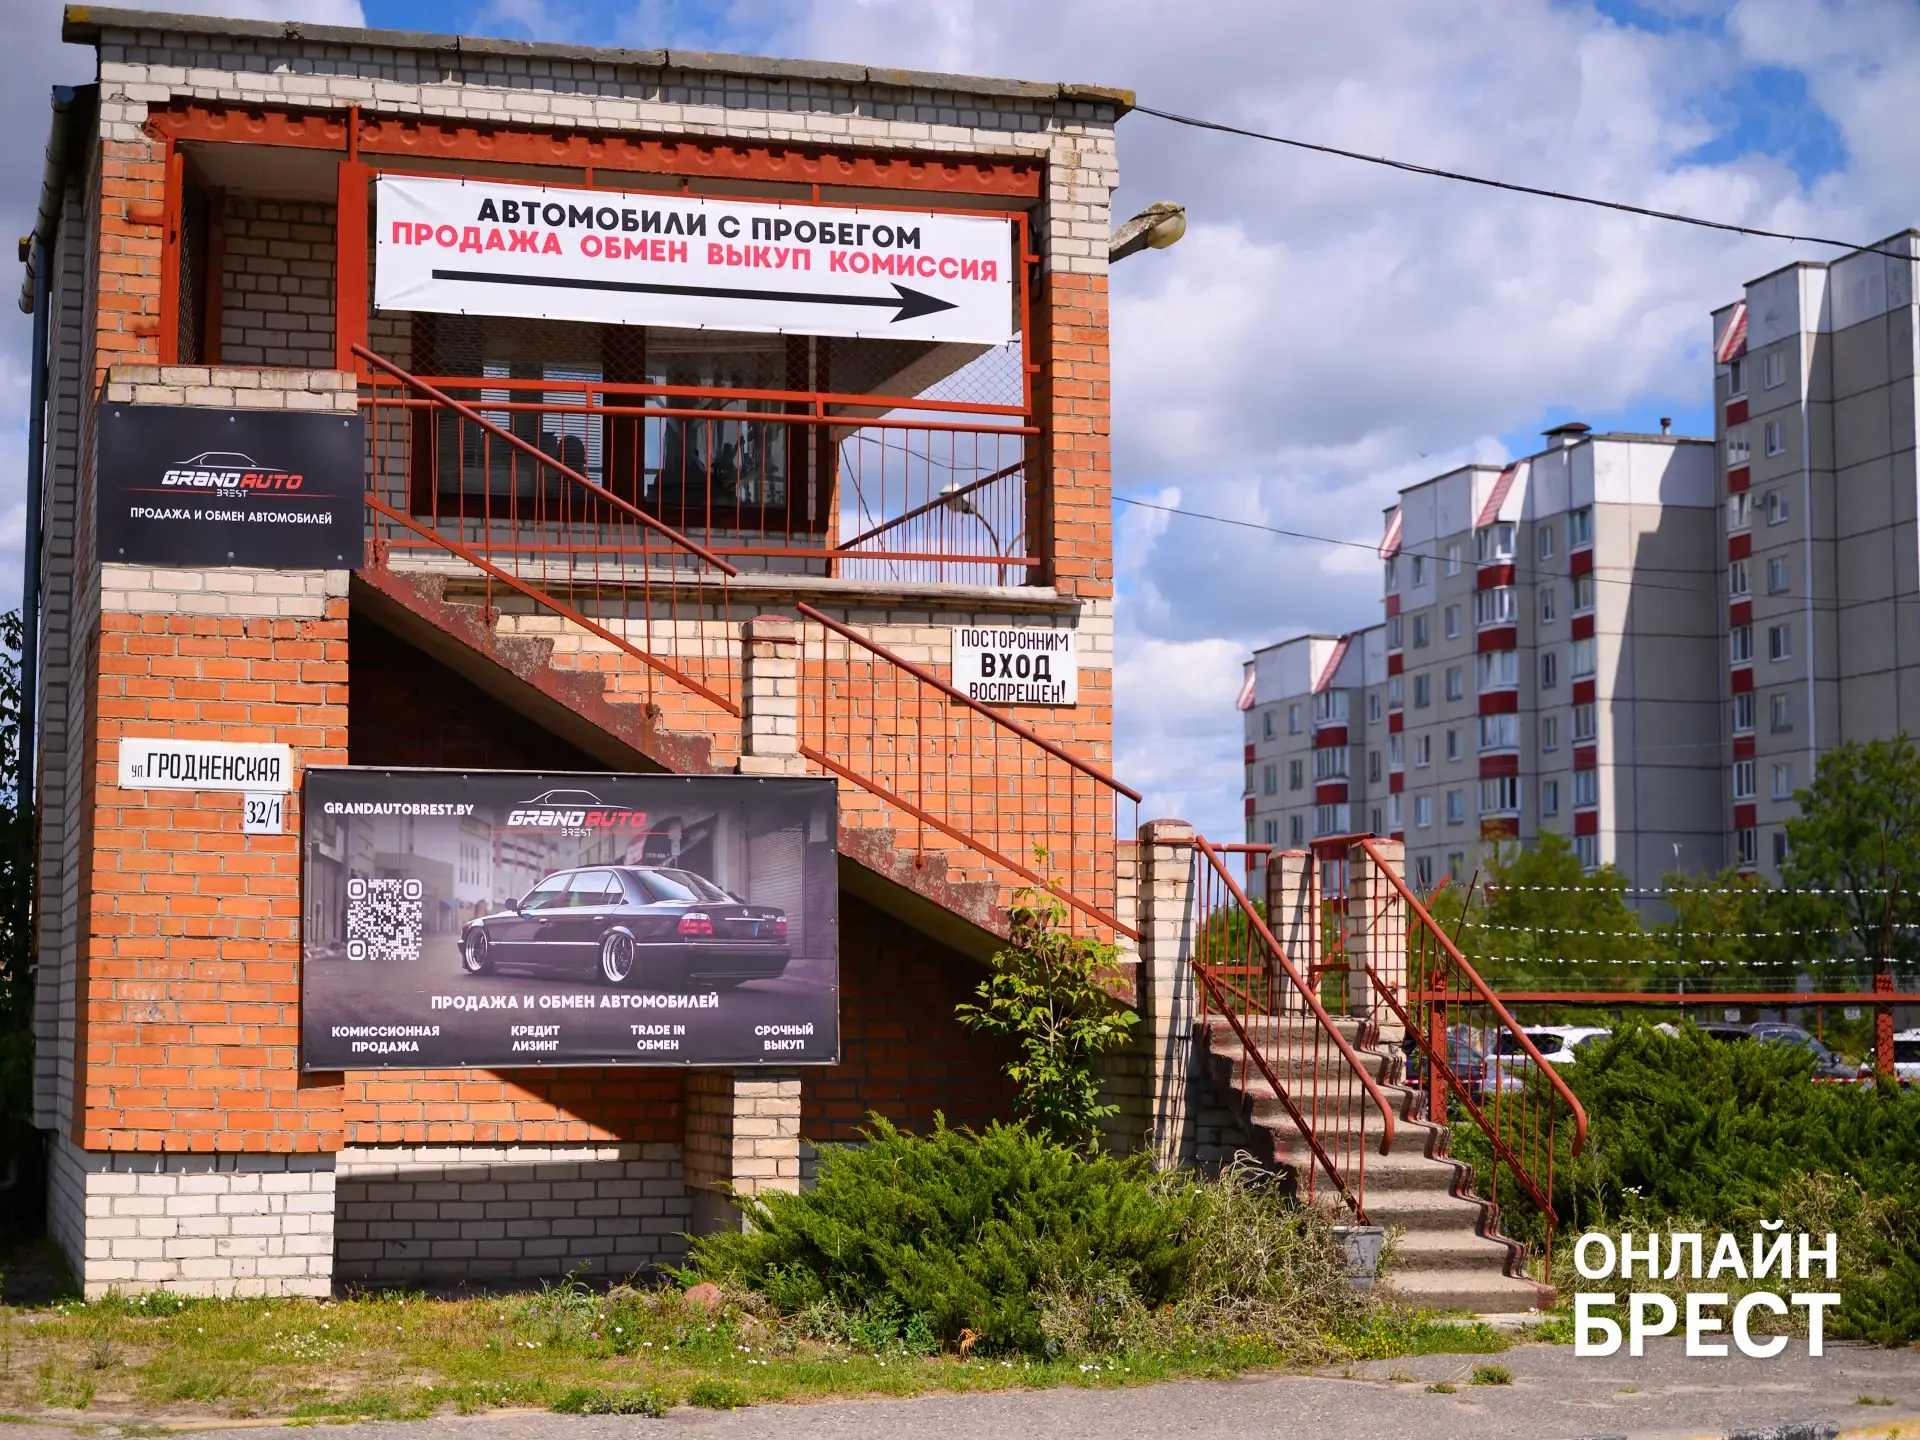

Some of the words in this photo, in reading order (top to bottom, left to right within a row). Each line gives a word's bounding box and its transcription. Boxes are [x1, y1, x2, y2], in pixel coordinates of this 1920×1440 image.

[477, 198, 707, 237] АВТОМОБИЛИ
[718, 215, 741, 239] С
[751, 217, 921, 250] ПРОБЕГОМ
[392, 221, 563, 255] ПРОДАЖА
[580, 235, 688, 263] ОБМЕН
[707, 242, 812, 271] ВЫКУП
[829, 250, 998, 282] КОМИССИЯ
[216, 488, 249, 498] BREST
[130, 507, 191, 520] ПРОДАЖА
[194, 509, 202, 520] И
[205, 510, 245, 522] ОБМЕН
[247, 511, 333, 525] АВТОМОБИЛЕЙ
[961, 629, 1069, 652] ПОСТОРОННИМ
[981, 652, 1052, 683] ВХОД
[969, 679, 1066, 704] ВОСПРЕЩЕН!
[146, 752, 280, 782] ГРОДНЕНСКАЯ
[246, 798, 280, 828] 32/1
[323, 802, 474, 816] GRANDAUTOBREST.BY
[561, 828, 593, 837] BREST
[431, 995, 518, 1011] ПРОДАЖА
[523, 995, 534, 1008] И
[539, 995, 595, 1009] ОБМЕН
[600, 992, 719, 1008] АВТОМОБИЛЕЙ
[331, 1025, 440, 1037] КОМИССИОННАЯ
[511, 1025, 560, 1037] КРЕДИТ
[631, 1025, 670, 1035] TRADE
[673, 1025, 686, 1035] IN
[754, 1022, 814, 1036] СРОЧНЫЙ
[352, 1041, 420, 1054] ПРОДАЖА
[512, 1041, 560, 1051] ЛИЗИНГ
[637, 1040, 679, 1050] ОБМЕН
[764, 1040, 805, 1051] ВЫКУП
